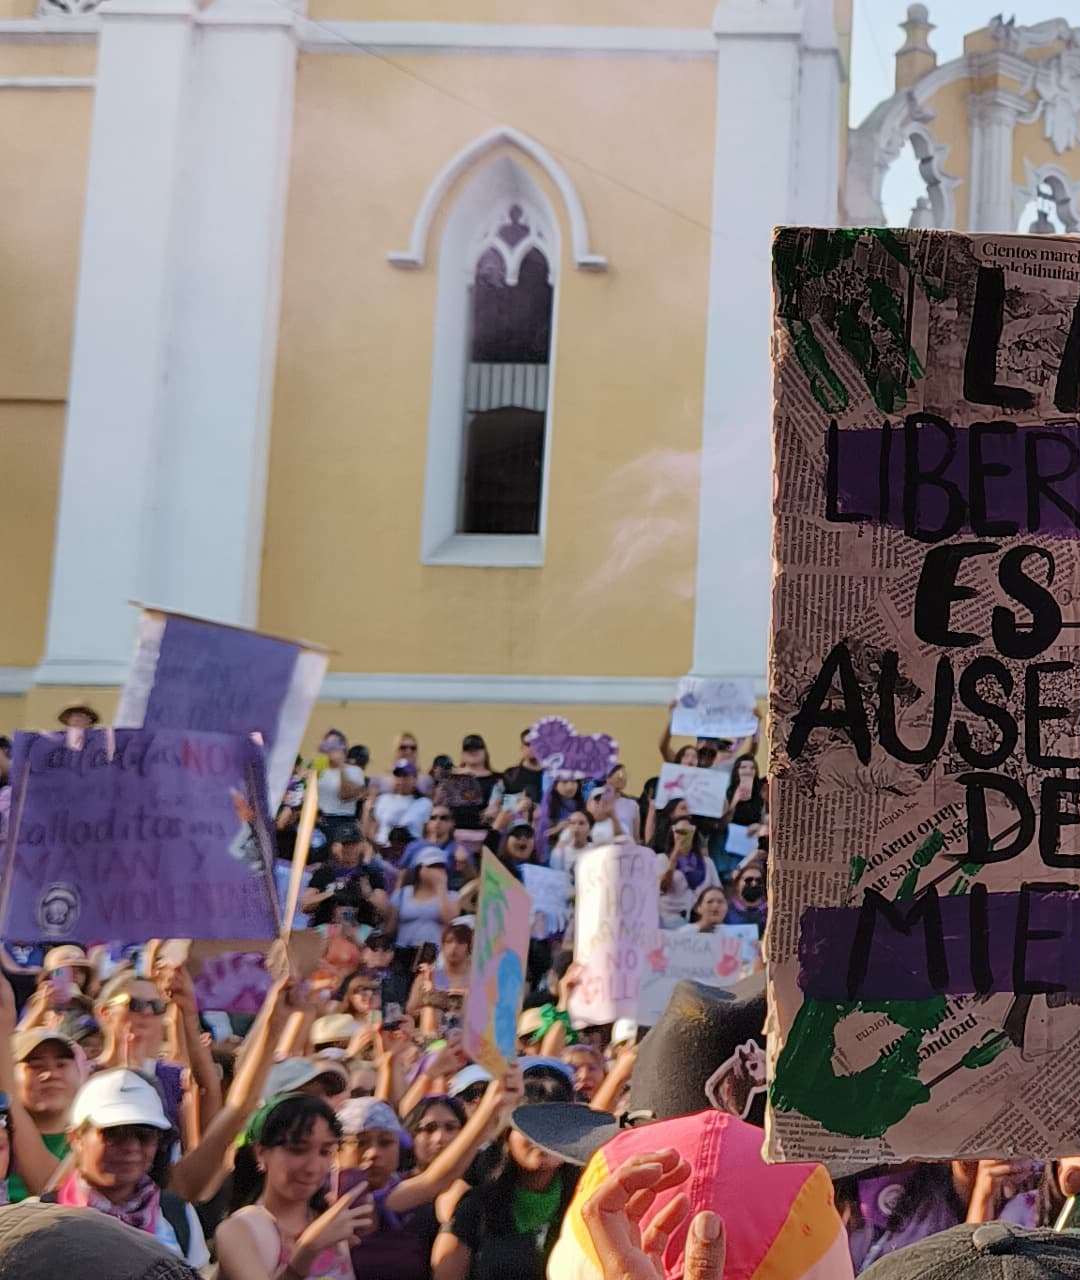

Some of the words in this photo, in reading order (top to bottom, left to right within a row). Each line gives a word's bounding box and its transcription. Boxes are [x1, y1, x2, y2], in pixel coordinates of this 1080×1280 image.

[982, 242, 1037, 259] Cientos
[913, 541, 1063, 659] ES
[918, 803, 964, 834] alario
[866, 830, 917, 872] mayor
